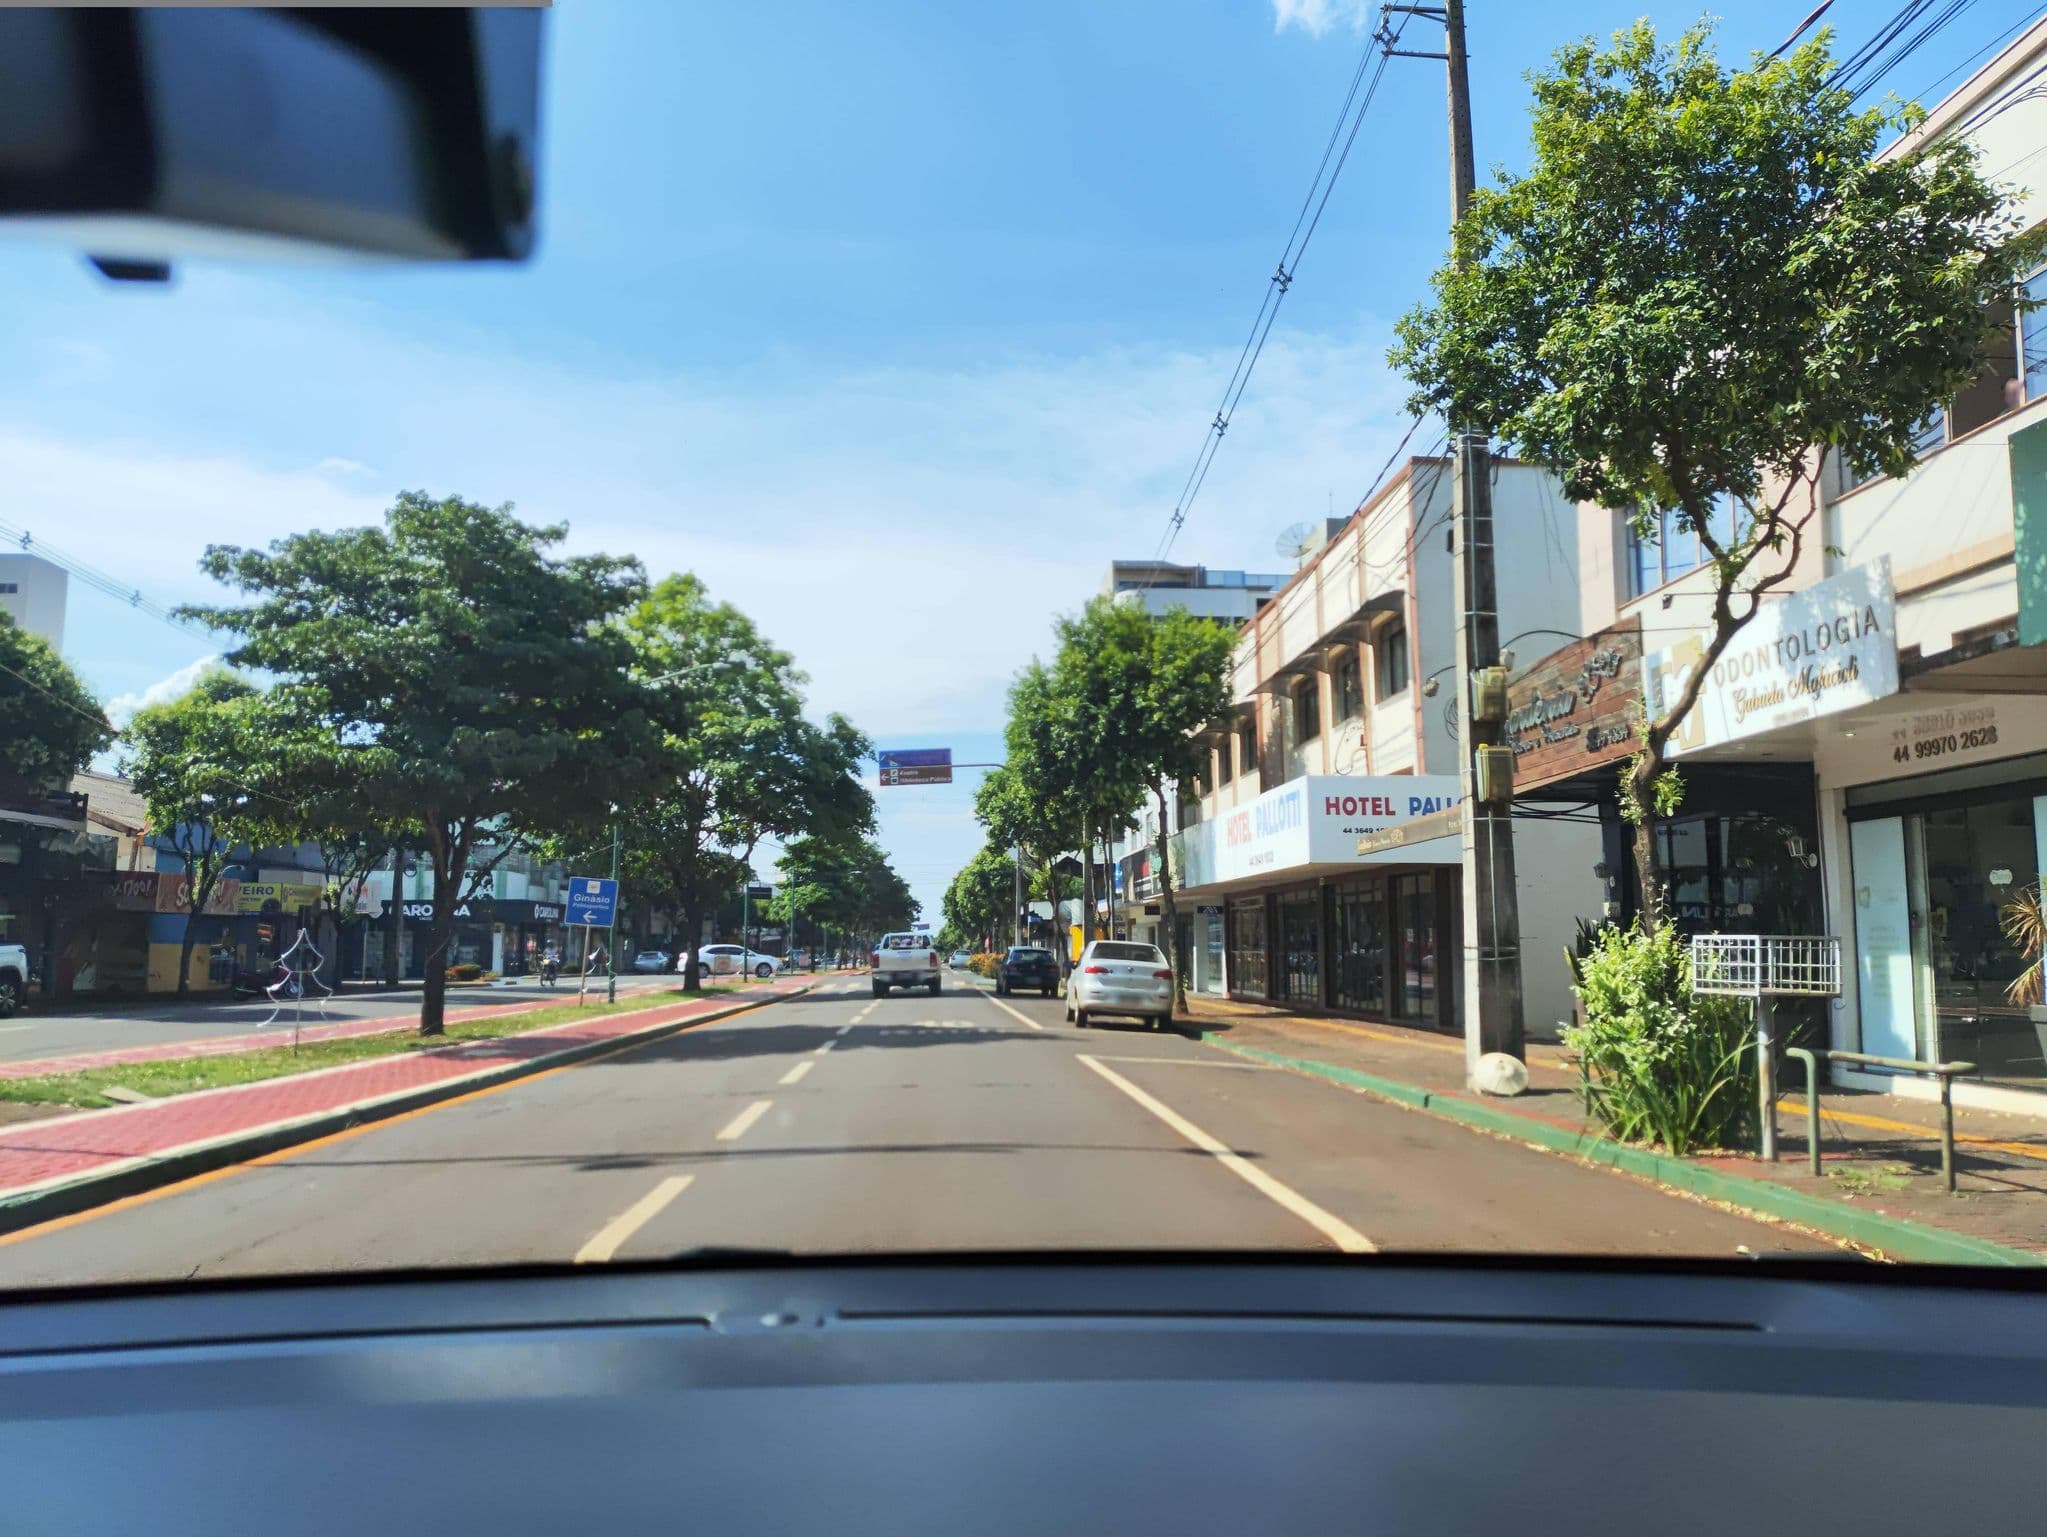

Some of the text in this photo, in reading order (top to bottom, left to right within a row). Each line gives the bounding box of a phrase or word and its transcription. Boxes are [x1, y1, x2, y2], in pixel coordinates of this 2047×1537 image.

[1713, 604, 1880, 689] ODONTOLOGIA
[1894, 744, 1910, 763] 44
[1915, 734, 1957, 759] 99970
[1325, 796, 1462, 816] HOTEL PALL
[1227, 789, 1302, 848] HOTEL PALLOTTI
[238, 885, 275, 896] EIRO
[573, 893, 610, 904] Ginásio
